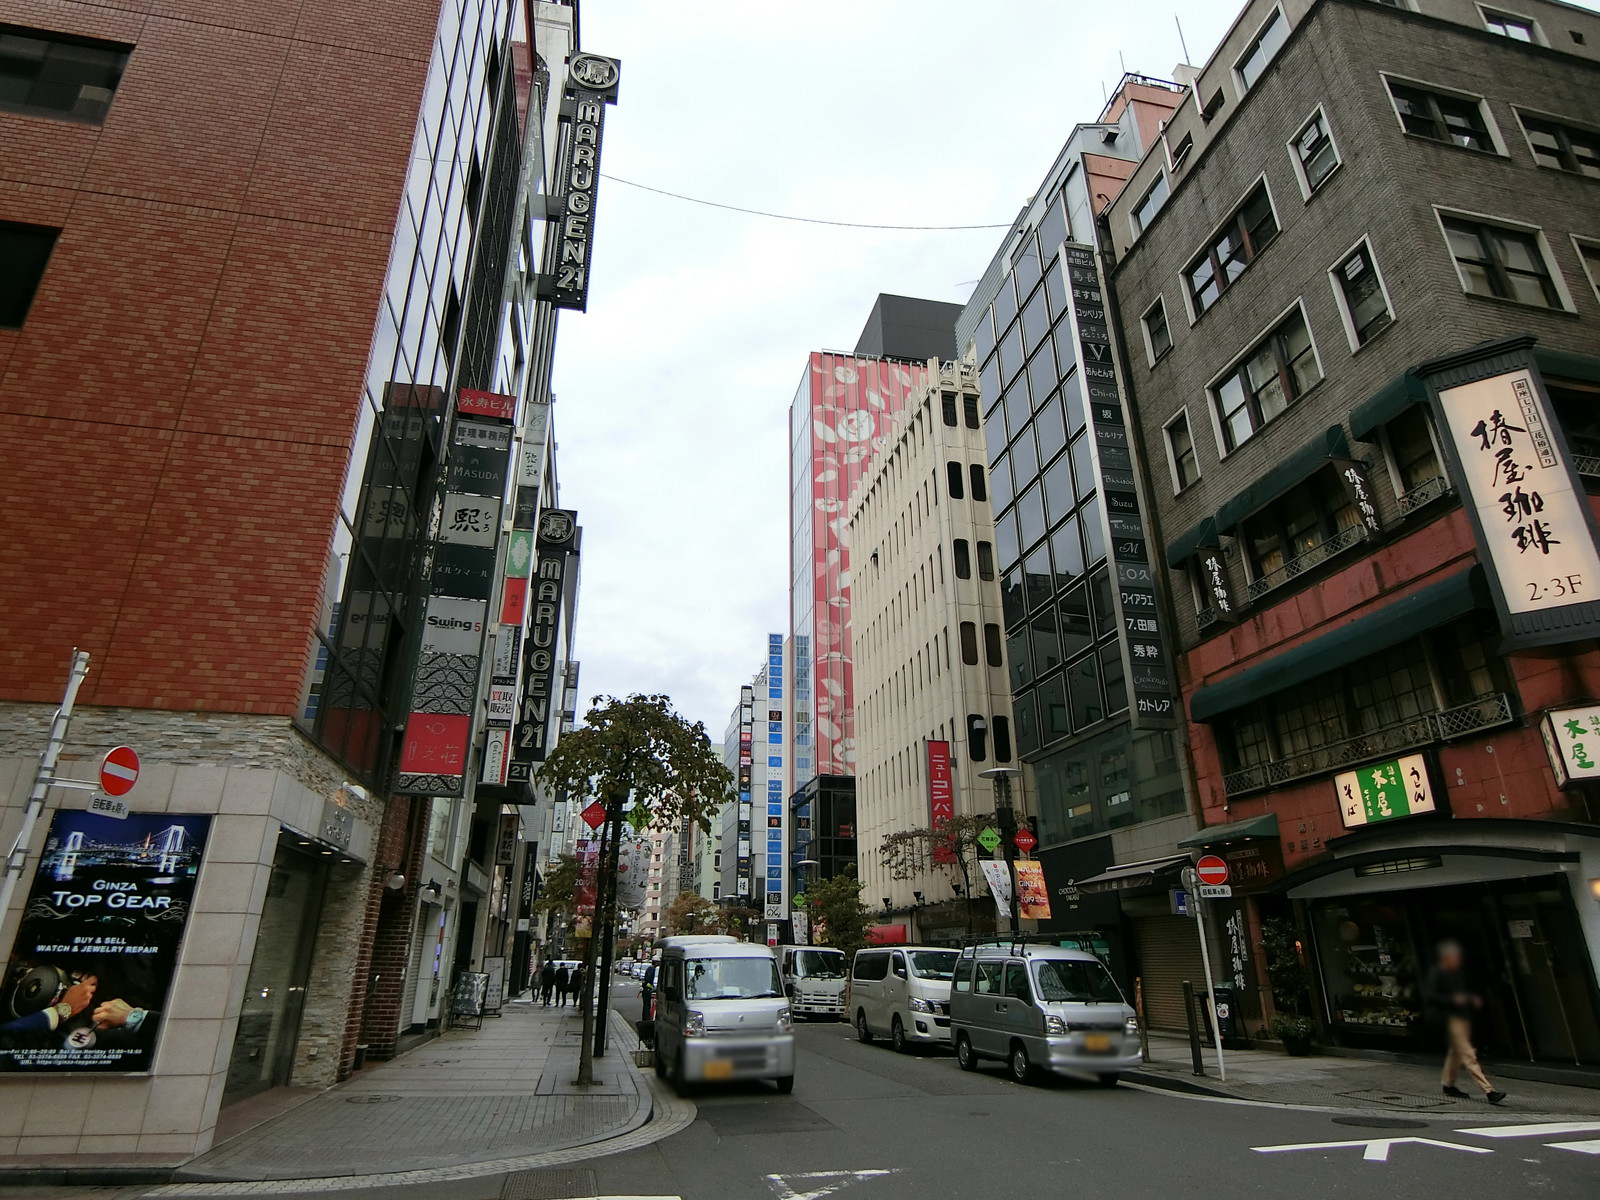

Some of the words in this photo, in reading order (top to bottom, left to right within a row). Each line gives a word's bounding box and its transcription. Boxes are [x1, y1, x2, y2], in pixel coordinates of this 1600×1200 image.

[562, 101, 600, 264] MARUGEN
[557, 266, 584, 290] 21
[1087, 344, 1106, 361] V
[461, 396, 514, 410] 永寿ビル
[458, 427, 509, 442] 管理事務所
[454, 466, 499, 480] MASUDA
[1471, 410, 1561, 554] 椿屋珈琲
[483, 511, 492, 532] ひろ
[436, 565, 488, 577] メルクマール
[1121, 593, 1154, 606] ワイアラエ
[428, 616, 472, 631] Swing
[474, 622, 481, 632] 5
[522, 557, 563, 722] MARUGEN
[1134, 676, 1168, 686] Crescendo
[492, 691, 513, 702] 買取
[490, 702, 512, 714] 販売
[1138, 699, 1170, 712] カトレア
[519, 724, 544, 748] 21
[1563, 719, 1595, 768] 木屋
[511, 766, 528, 777] 21
[1371, 769, 1392, 816] 木屋
[1410, 767, 1426, 803] うどん
[93, 798, 126, 814] 自転車を除く
[1344, 784, 1357, 816] そば
[93, 880, 138, 891] GINZA
[1202, 888, 1229, 896] 自転車を除く
[52, 891, 102, 907] TOP
[107, 892, 172, 908] GEAR
[104, 937, 127, 945] SELL
[81, 945, 124, 953] JEWELRY
